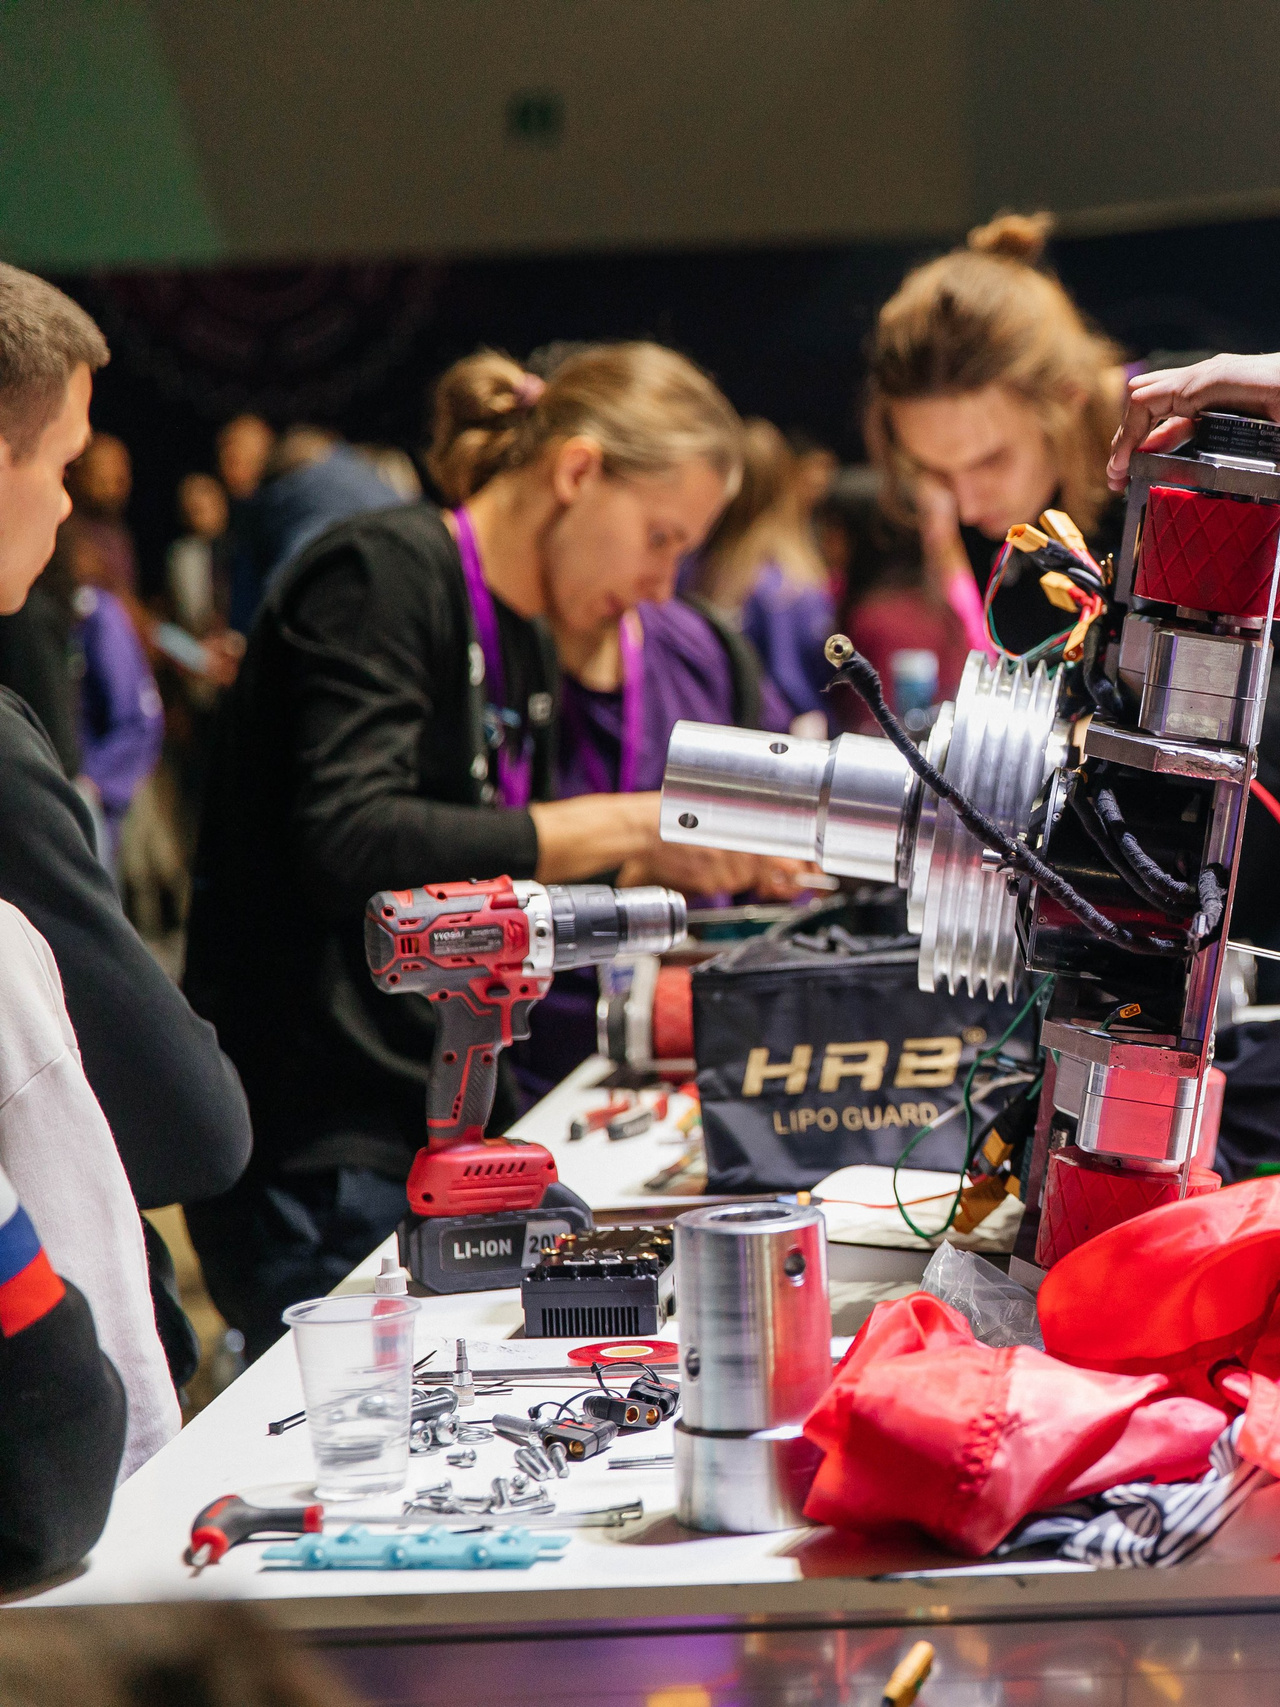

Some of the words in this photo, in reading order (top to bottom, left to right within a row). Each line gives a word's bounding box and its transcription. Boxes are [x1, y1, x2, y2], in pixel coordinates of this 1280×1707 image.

[773, 1106, 839, 1135] LIPO
[841, 1101, 939, 1132] GUARD
[453, 1238, 512, 1260] LI-ION
[529, 1234, 556, 1254] 20
